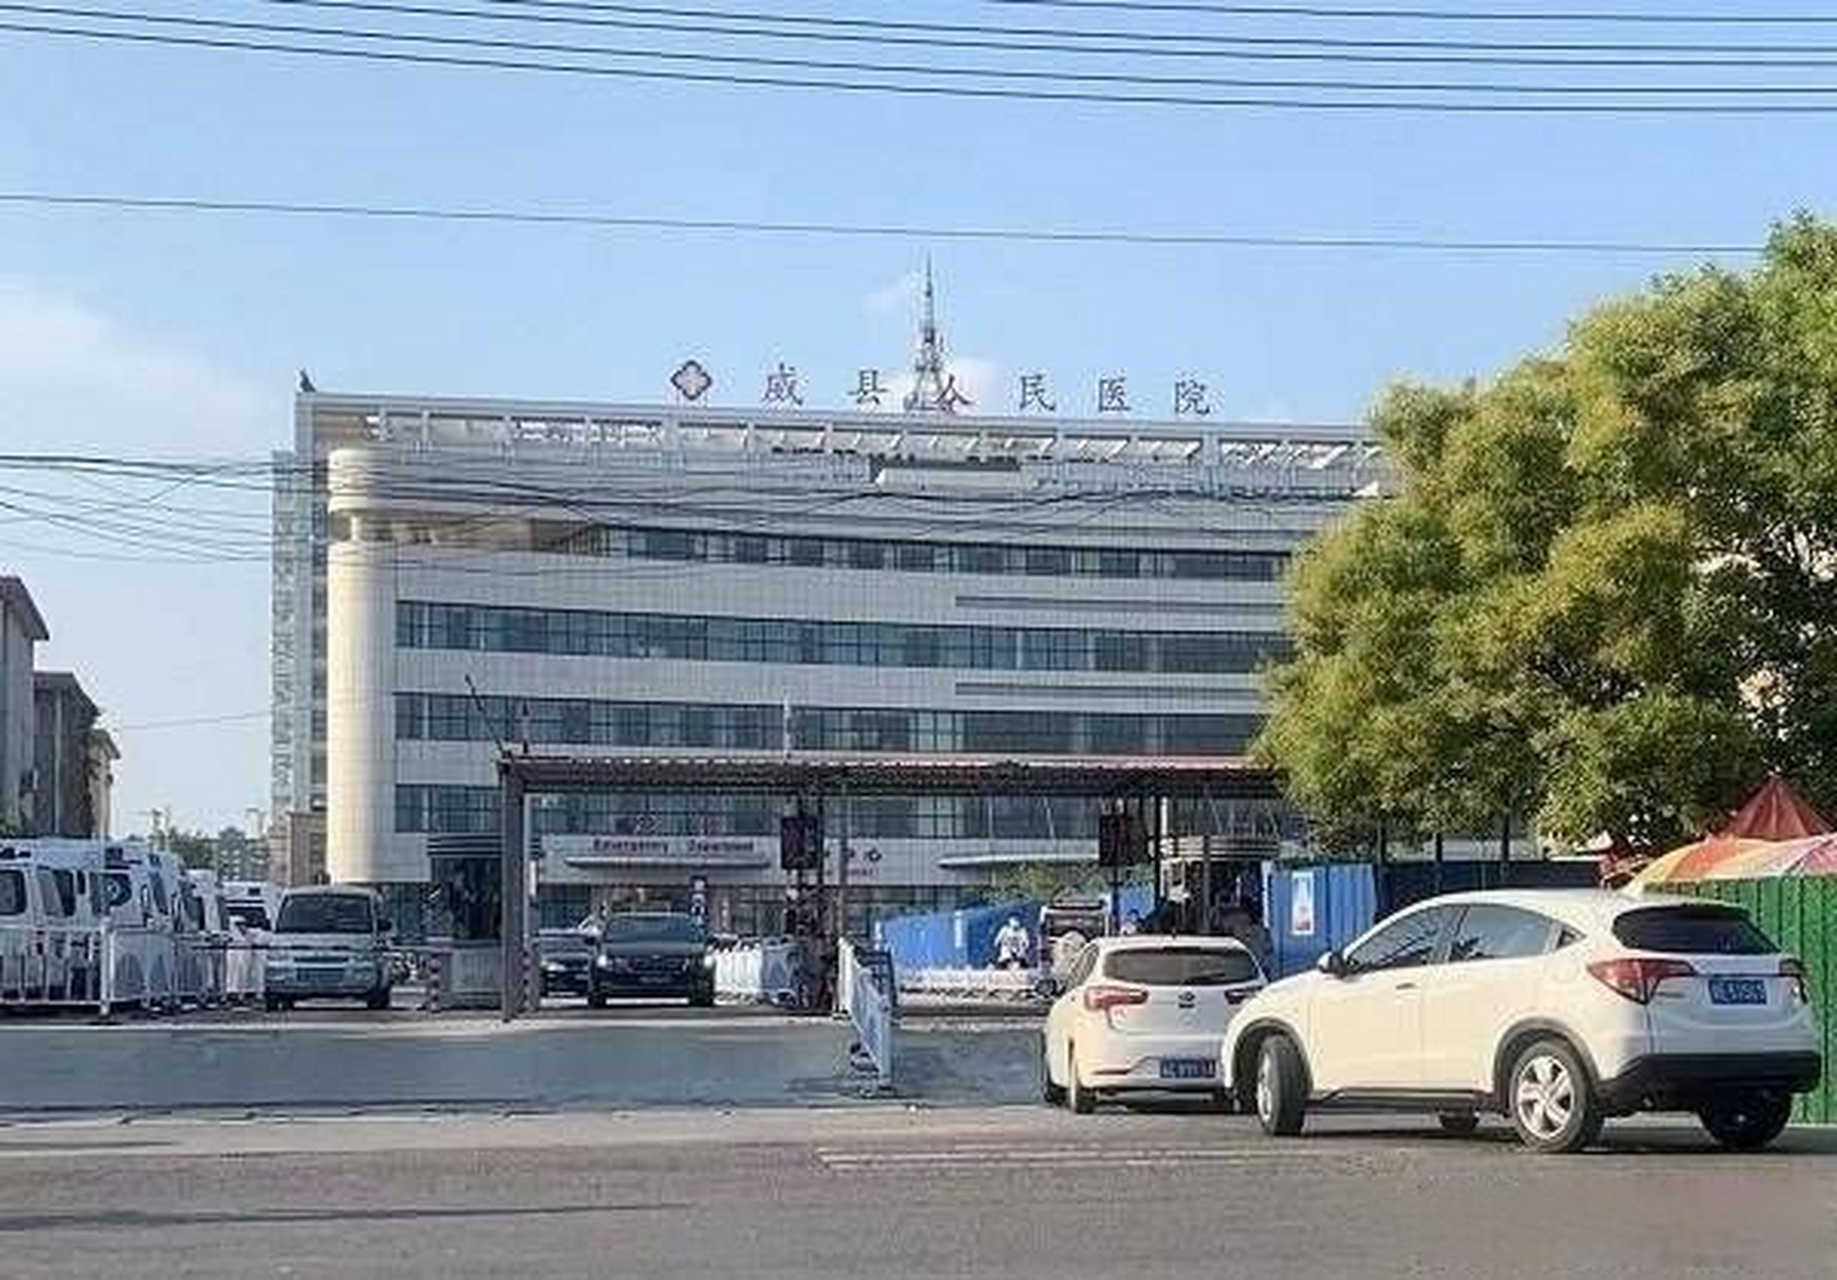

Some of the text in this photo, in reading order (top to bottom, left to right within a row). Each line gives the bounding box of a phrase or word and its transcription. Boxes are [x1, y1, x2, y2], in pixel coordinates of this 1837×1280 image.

[761, 361, 1211, 416] 威县人民医院
